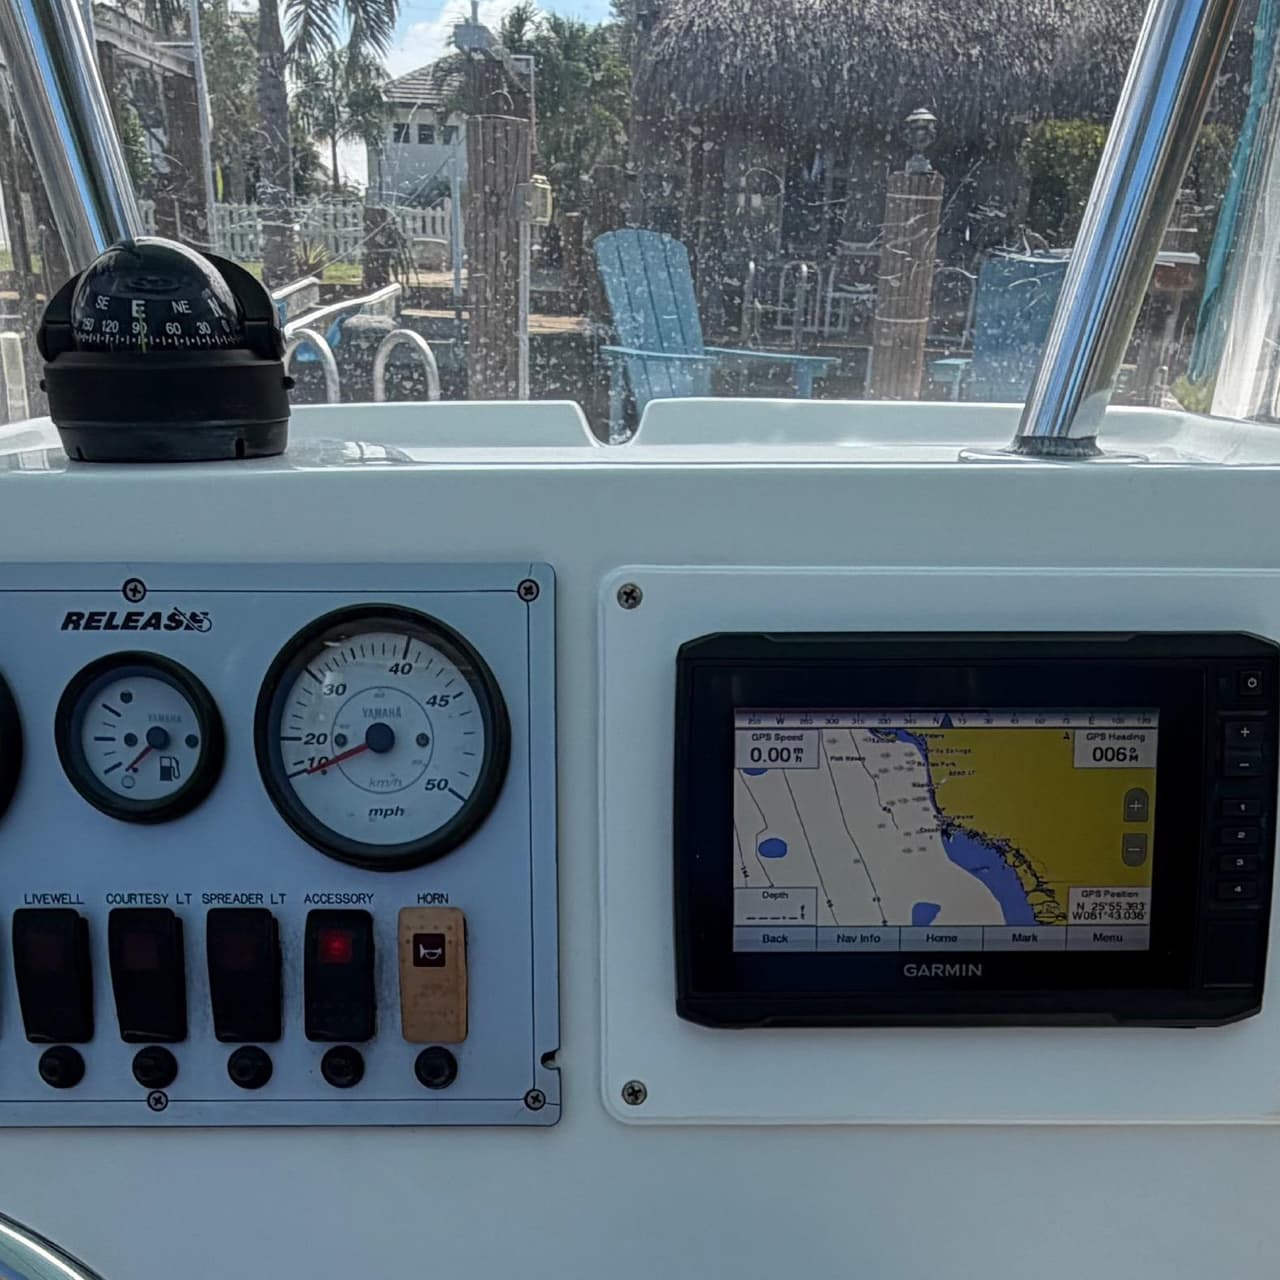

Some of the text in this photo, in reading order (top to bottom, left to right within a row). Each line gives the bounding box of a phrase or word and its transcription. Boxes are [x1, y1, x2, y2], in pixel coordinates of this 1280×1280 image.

[95, 295, 111, 310] SE
[171, 300, 192, 314] NE
[131, 299, 146, 319] E
[102, 319, 119, 333] 120
[132, 322, 147, 334] 90
[165, 322, 181, 335] 60
[196, 321, 211, 335] 30
[388, 662, 413, 675] 40
[323, 683, 347, 696] 30
[425, 695, 451, 708] 45
[362, 707, 402, 719] YAMAHA
[304, 733, 328, 745] 20
[752, 733, 804, 743] GPS Speed
[1086, 732, 1145, 742] GPS Heading
[750, 747, 791, 763] 0.00
[1093, 747, 1127, 762] 006
[425, 778, 449, 791] 50
[368, 806, 405, 819] mph
[24, 893, 85, 905] LIVEWELL
[106, 893, 192, 905] COURTESY LT
[202, 893, 287, 905] SPREADER LT
[304, 893, 374, 905] ACCESSORY
[417, 893, 449, 905] HORN
[762, 891, 788, 901] Depth
[763, 933, 788, 944] Back
[836, 933, 881, 944] Nav Info
[926, 933, 958, 944] Home
[1011, 933, 1038, 943] Mark
[1093, 933, 1123, 943] Menu
[903, 963, 983, 977] GARMIN
